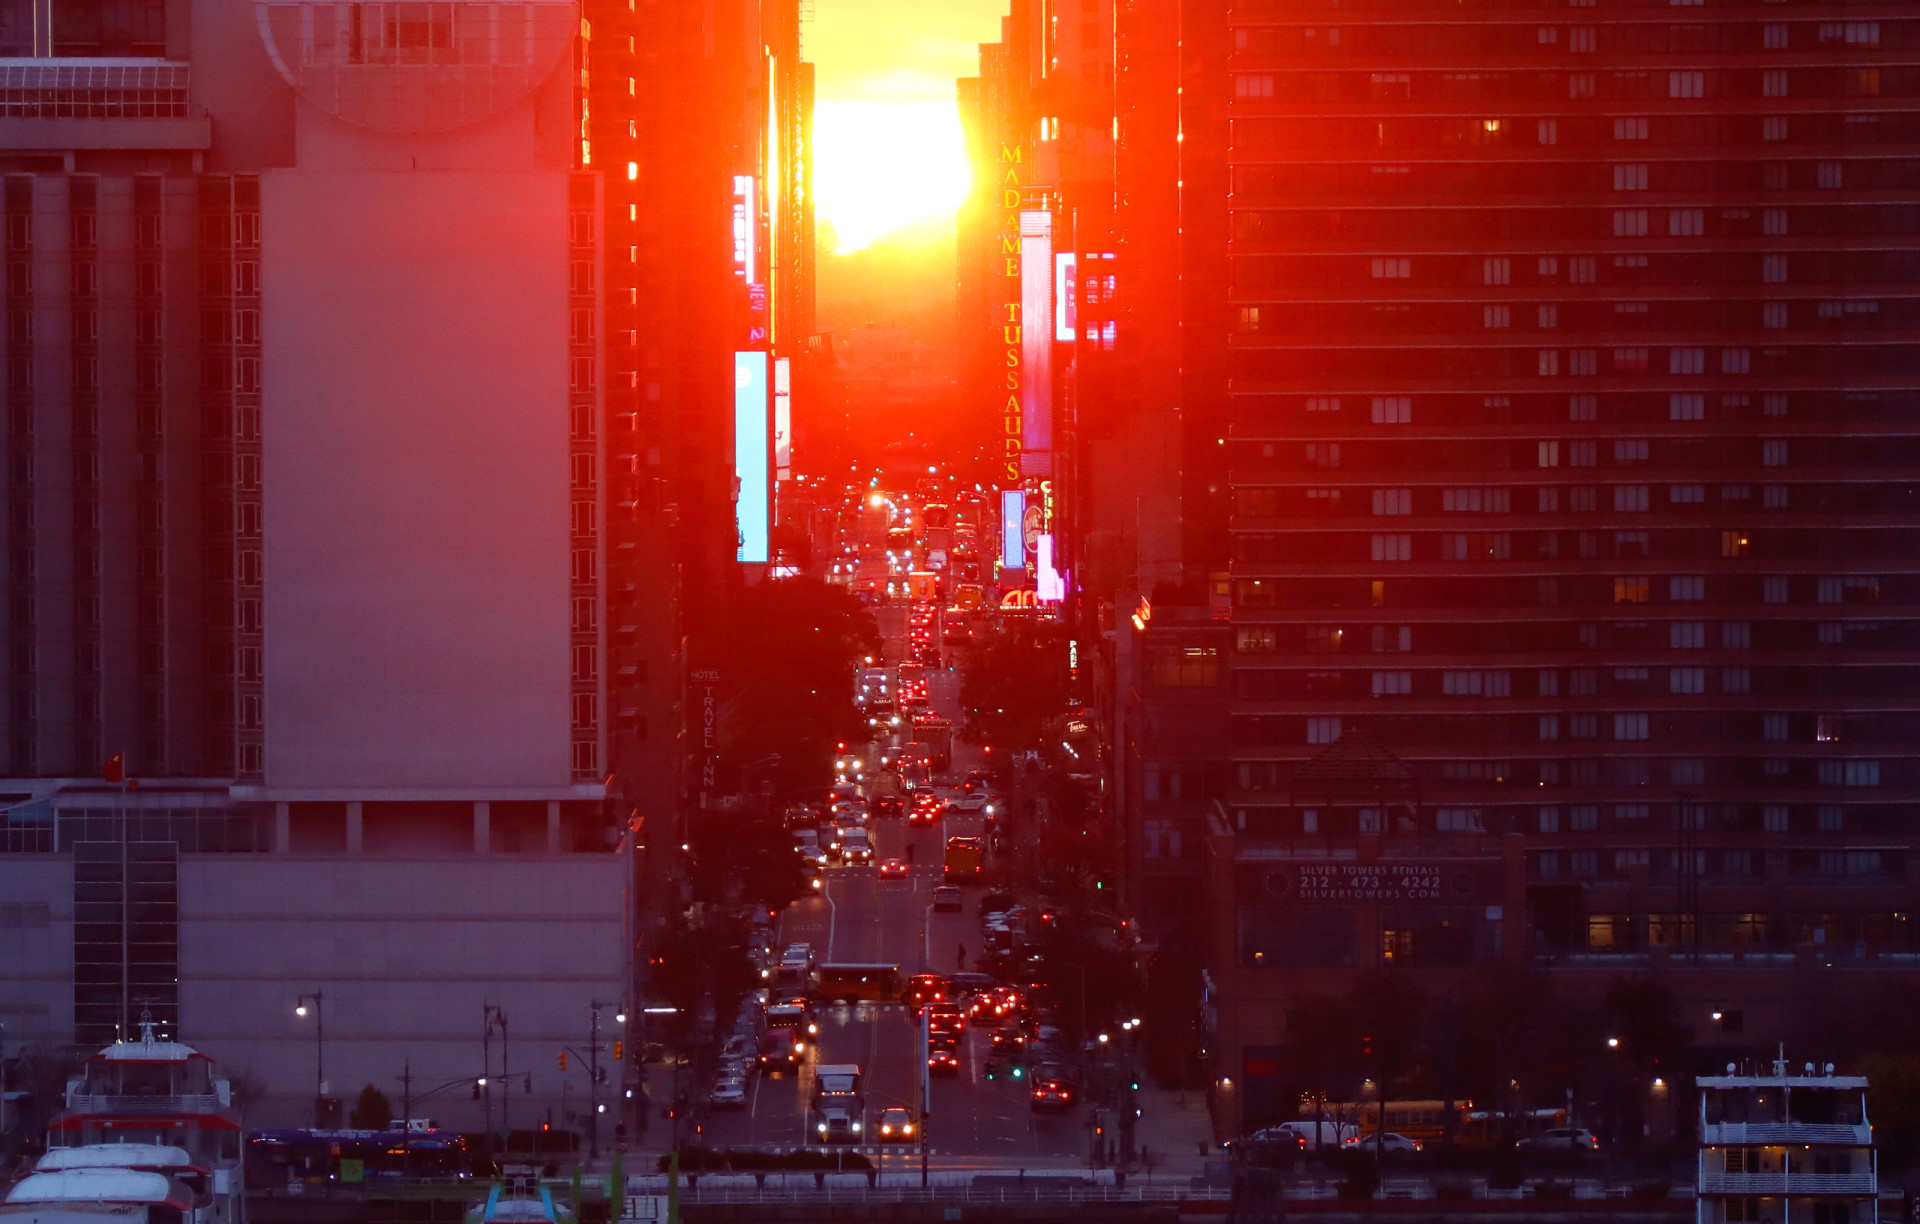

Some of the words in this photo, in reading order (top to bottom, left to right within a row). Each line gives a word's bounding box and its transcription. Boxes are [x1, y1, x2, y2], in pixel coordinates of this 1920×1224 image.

[1001, 144, 1022, 277] MADAME
[1069, 640, 1078, 668] PARK
[691, 670, 721, 680] HOTEL
[703, 686, 714, 748] TRAVEL
[703, 756, 714, 786] INN
[1299, 866, 1338, 875] SILVER
[1342, 866, 1387, 875] TOWERS
[1392, 866, 1441, 875] RENTALS
[1300, 876, 1329, 888] 212
[1350, 876, 1380, 888] 473
[1400, 876, 1441, 888] 4242
[358, 1130, 371, 1138] bus
